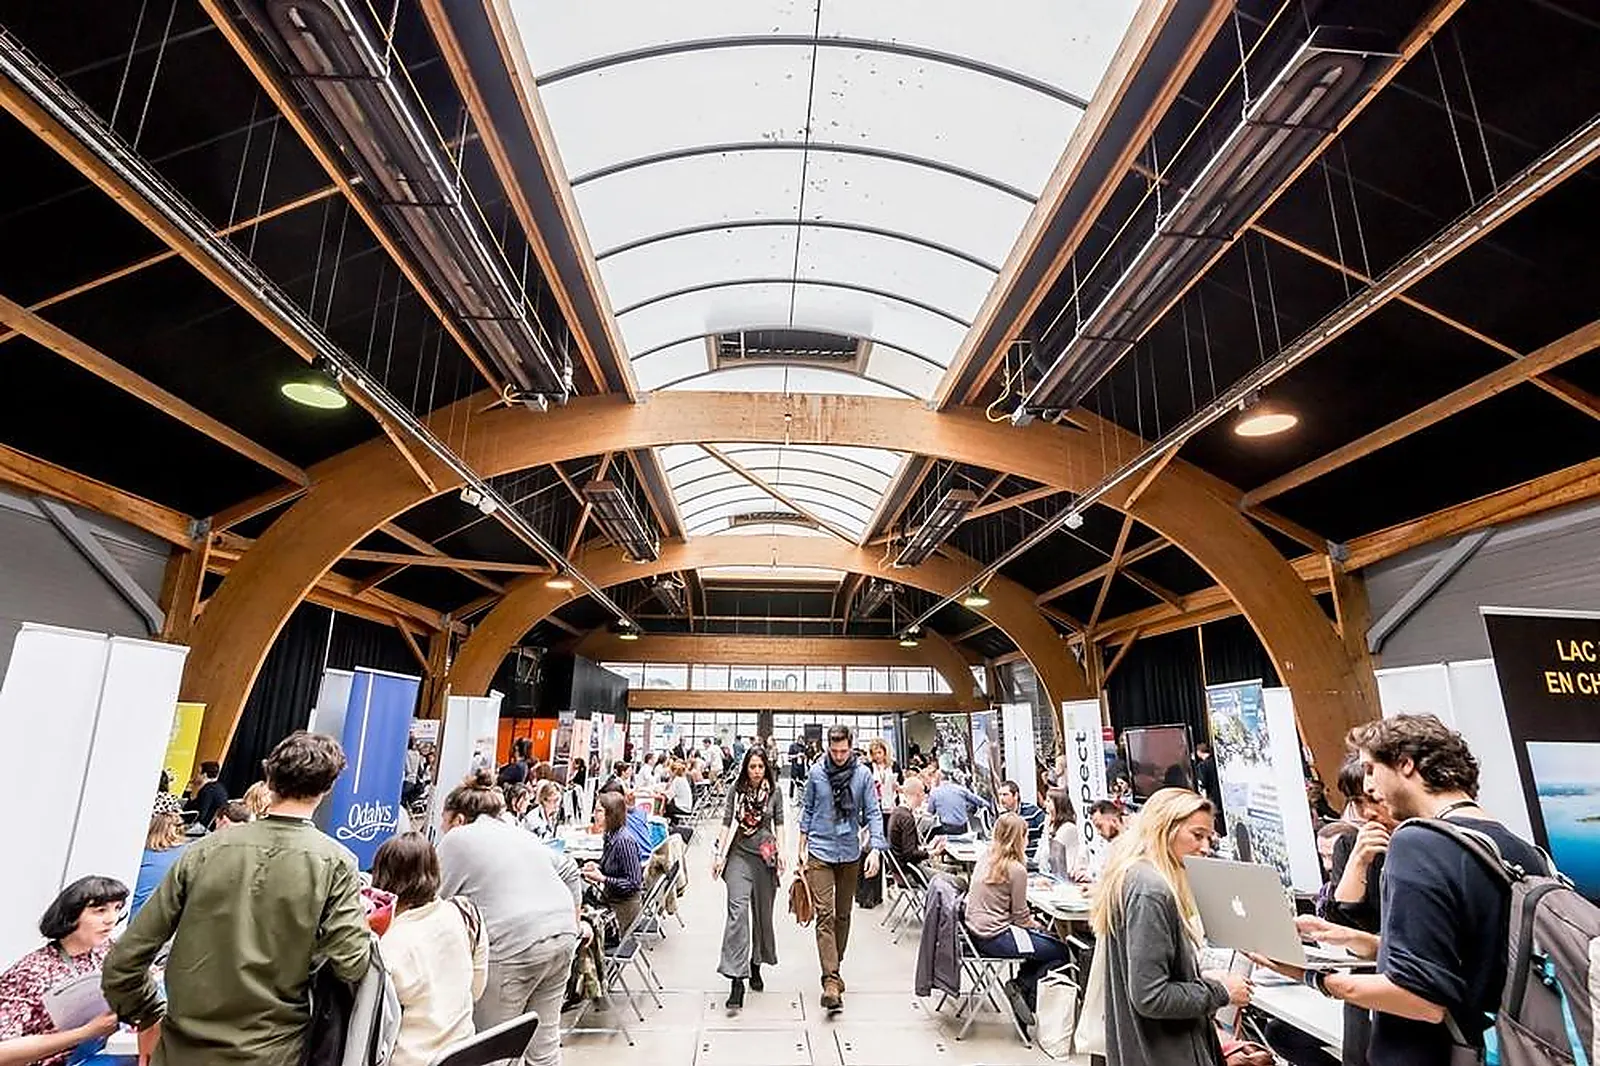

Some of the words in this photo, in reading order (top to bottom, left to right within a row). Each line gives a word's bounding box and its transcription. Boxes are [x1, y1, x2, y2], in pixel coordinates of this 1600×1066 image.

[1556, 639, 1597, 662] LAC
[1544, 671, 1575, 694] EN
[1075, 731, 1095, 854] ospect
[348, 799, 392, 828] Odalys
